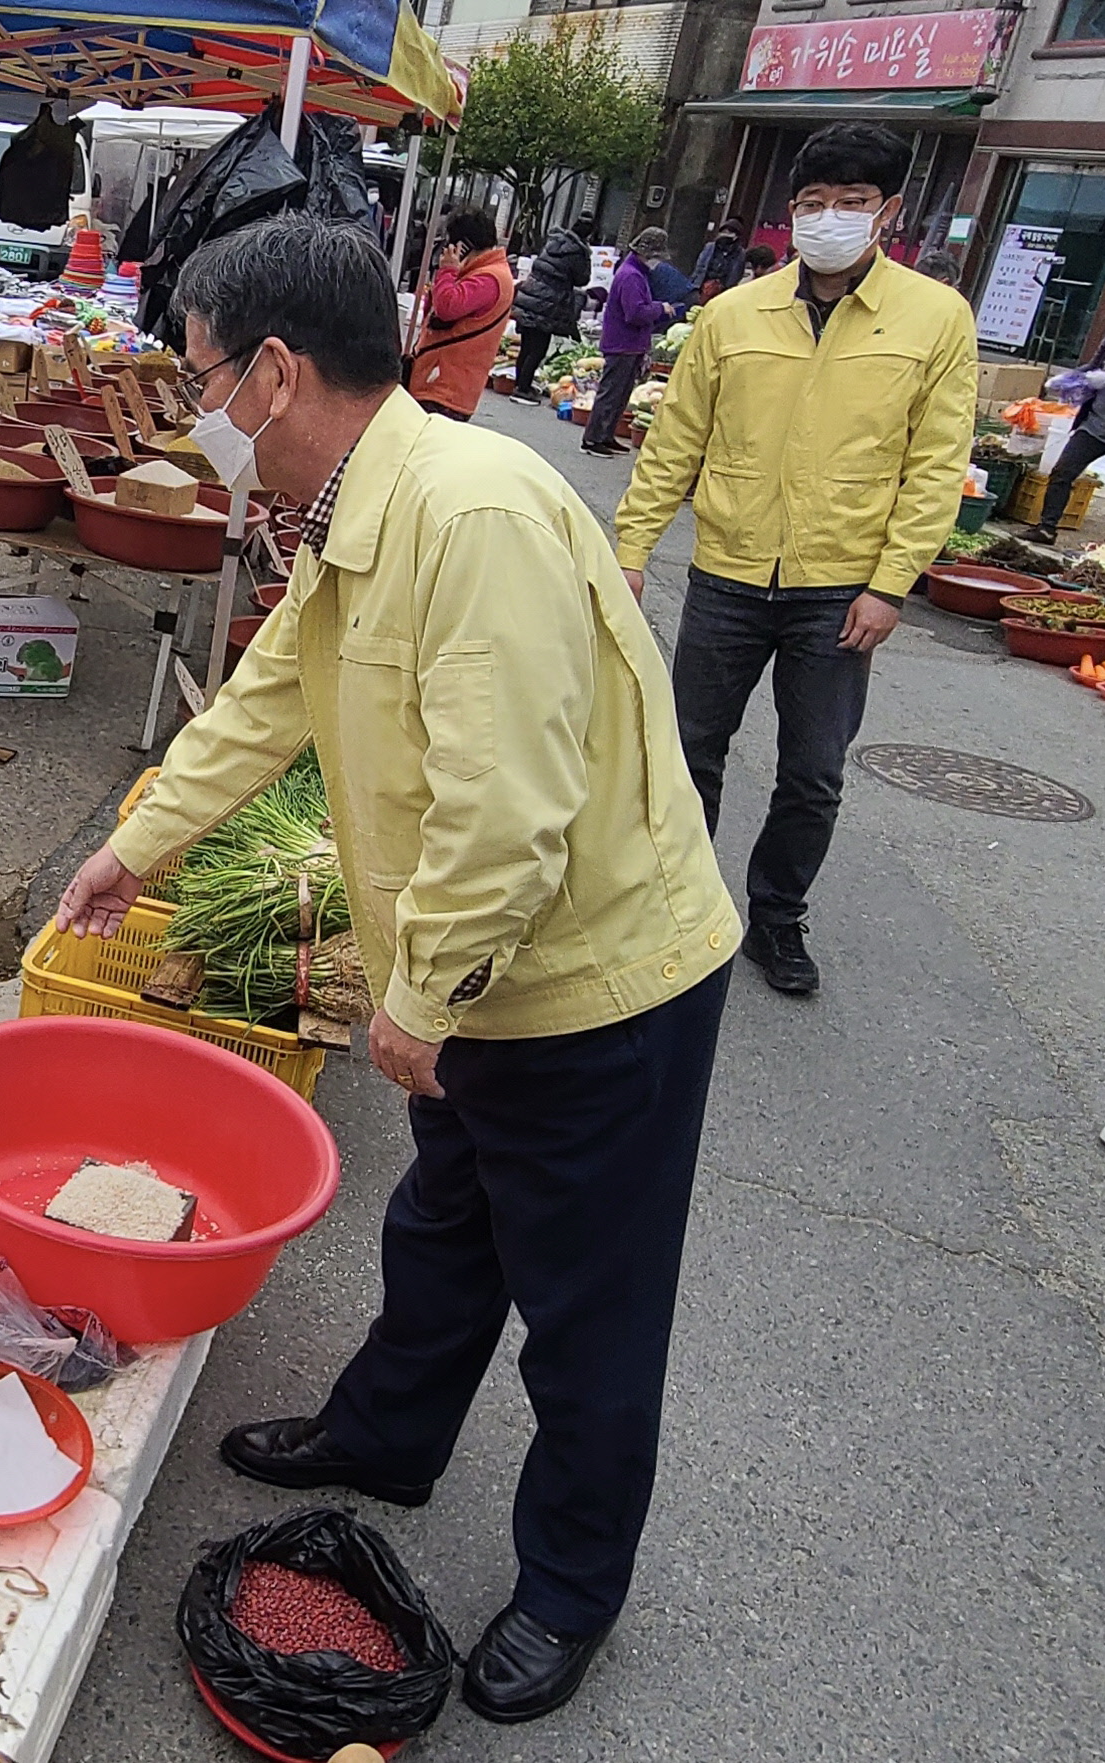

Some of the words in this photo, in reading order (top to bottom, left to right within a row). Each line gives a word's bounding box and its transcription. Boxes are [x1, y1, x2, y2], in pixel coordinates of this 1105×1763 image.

[790, 27, 858, 79] 가위손
[863, 22, 939, 79] 미용실
[0, 249, 29, 263] 2801
